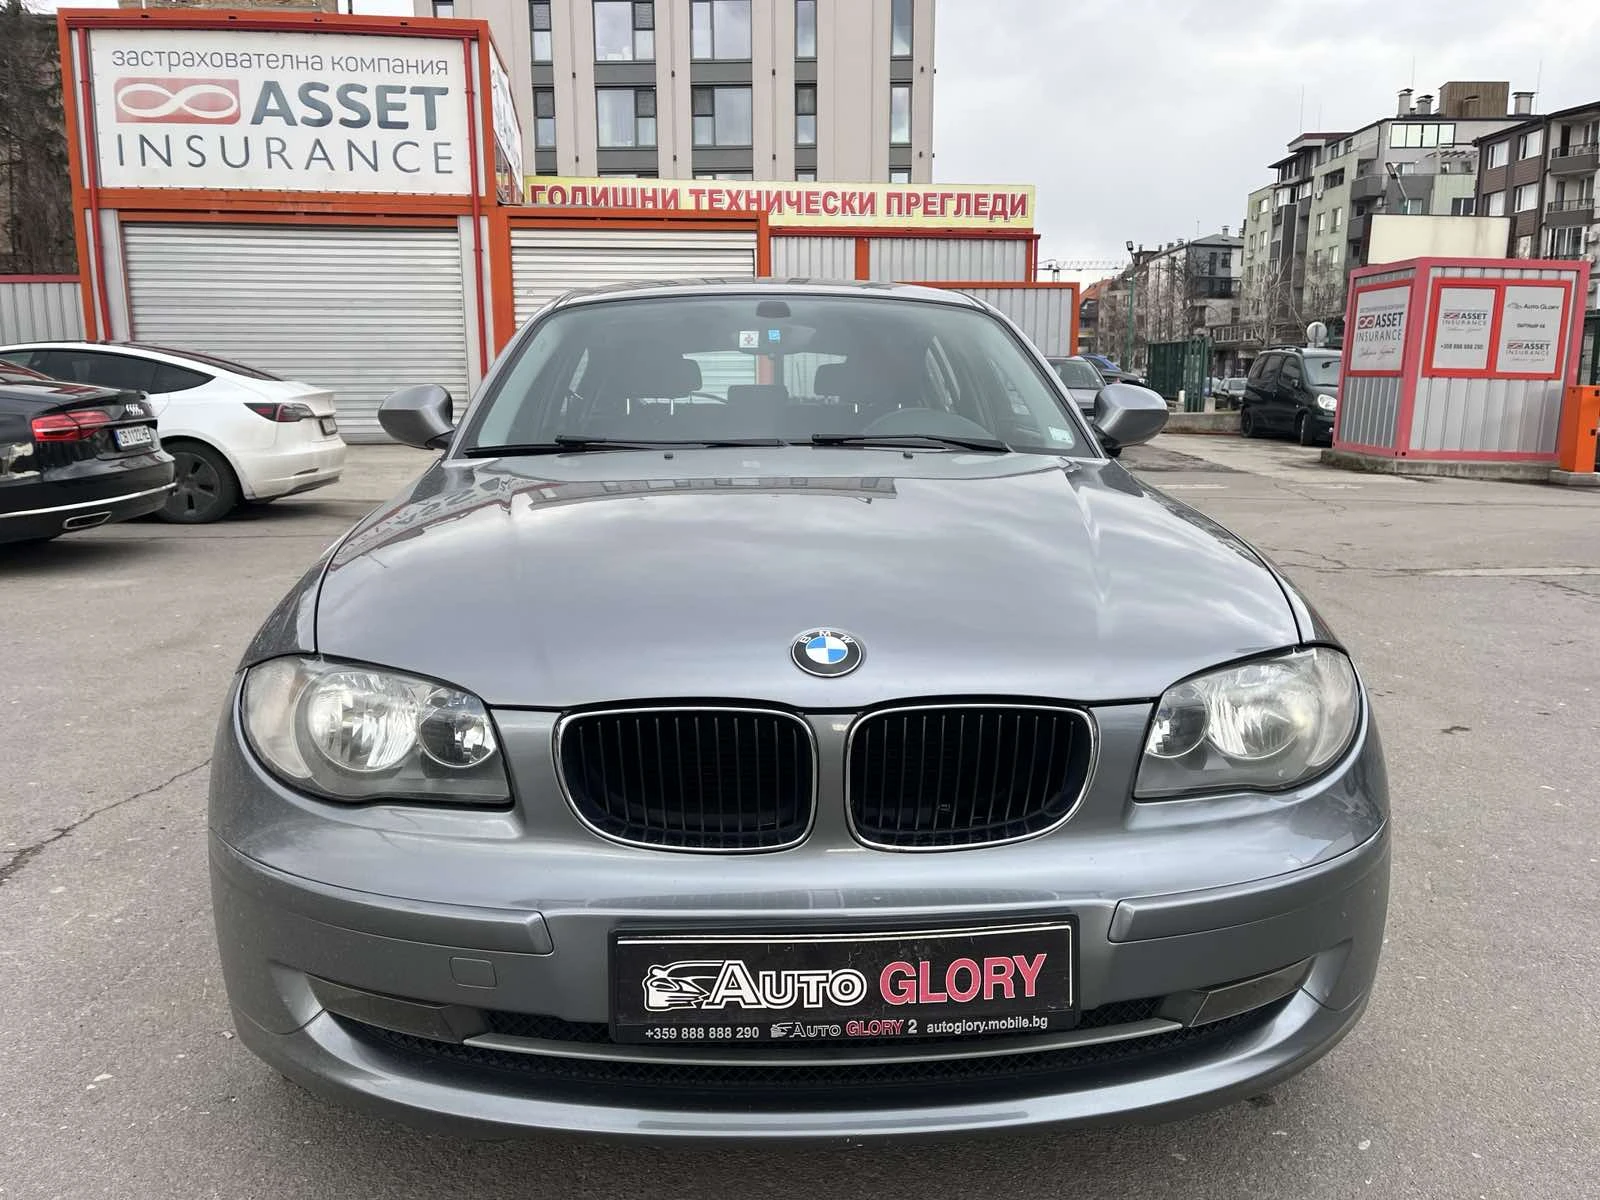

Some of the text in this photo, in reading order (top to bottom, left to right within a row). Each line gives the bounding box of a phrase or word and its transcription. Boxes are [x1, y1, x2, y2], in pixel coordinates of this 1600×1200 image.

[111, 50, 449, 76] застрахователна компания
[250, 80, 449, 131] ASSET
[116, 133, 454, 174] INSURANCE
[529, 184, 1028, 222] ГОДИШНИ ТЕХНИЧЕСКИ ПРЕГЛЕДИ
[1375, 312, 1404, 328] ASSET
[1461, 312, 1488, 320] ASSET
[1356, 329, 1402, 342] INSURANCE
[798, 629, 855, 644] BMW
[880, 952, 1048, 1006] GLORY
[645, 1026, 677, 1040] +359
[681, 1027, 705, 1039] 888
[709, 1026, 732, 1039] 888
[736, 1026, 760, 1039] 290
[846, 1019, 904, 1036] GLORY
[907, 1019, 918, 1034] 2
[926, 1016, 1048, 1035] autoglory.mobile.bg
